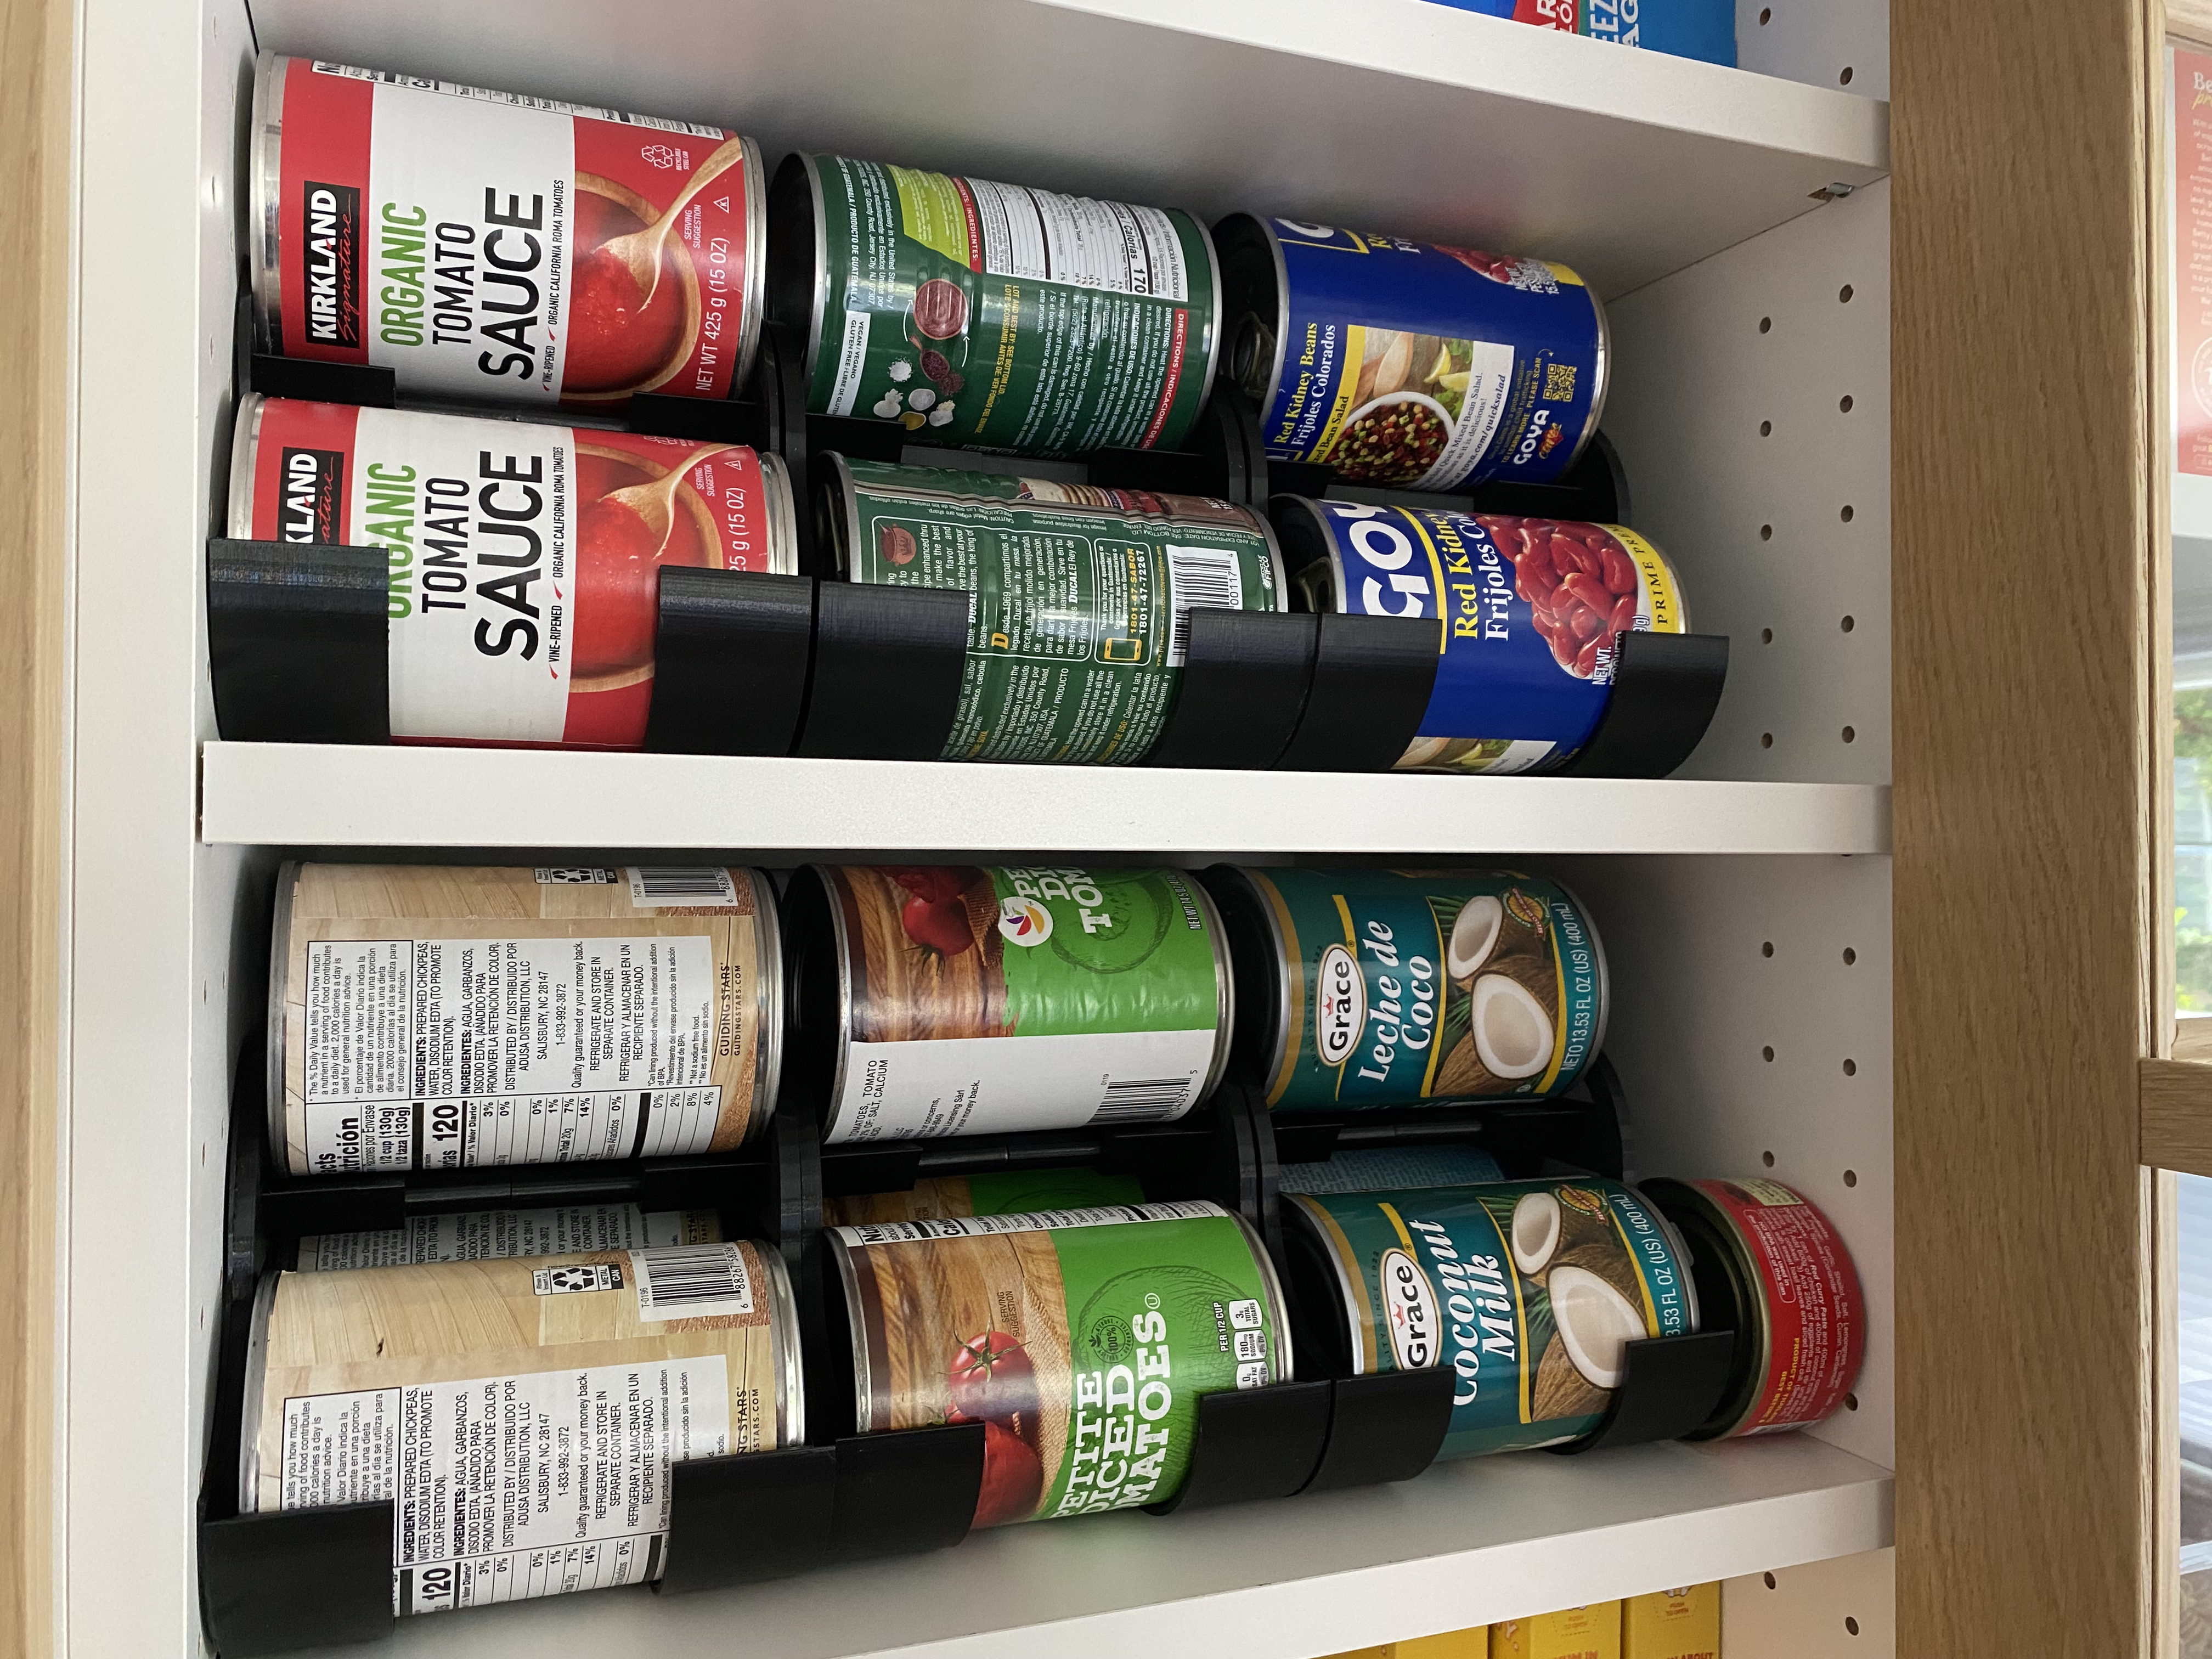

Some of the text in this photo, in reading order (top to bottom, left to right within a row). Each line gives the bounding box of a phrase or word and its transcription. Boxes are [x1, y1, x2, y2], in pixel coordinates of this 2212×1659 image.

[684, 210, 692, 240] SERVING
[693, 205, 702, 248] SUGGESTION
[311, 190, 336, 338] KIRKLAND
[338, 194, 359, 341] Signature
[381, 202, 426, 347] ORGANIC
[432, 222, 475, 345] TOMATO
[478, 187, 543, 380] SAUCE
[541, 180, 564, 382] VINE-RIPENED ORGANIC CALIFORNIA ROMA TOMATOES
[1132, 268, 1147, 294] 170
[695, 237, 729, 391] NET WT 425 g (15 OZ)
[848, 320, 857, 348] GLUTEN
[1009, 315, 1018, 333] BEST
[850, 321, 864, 379] VEGAN VEGANO
[1001, 358, 1014, 382] BOTTOM
[1007, 346, 1015, 357] SEE
[1153, 313, 1184, 430] DIRECTIONS INDICACIONES
[998, 384, 1006, 395] LID.
[1273, 323, 1317, 443] Red Kidney Beans
[1291, 325, 1335, 445] Frijoles Colorados
[1450, 373, 1482, 447] Mixed Bean Salad.
[1527, 358, 1542, 408] PLEASE SCAN
[1320, 397, 1348, 448] Bean Salad
[1514, 410, 1550, 464] GOYA
[286, 454, 317, 543] KLAND
[726, 487, 749, 535] (15 OZ)
[421, 478, 470, 613] TOMATO
[474, 451, 543, 661] SAUCE
[921, 524, 931, 573] enhanced thru
[1022, 536, 1032, 567] mejorada
[1262, 556, 1272, 580] FIFCO
[1319, 499, 1430, 618] GOY
[1001, 543, 1013, 610] 1969 compartimos
[1069, 571, 1078, 603] DUCAL
[1127, 548, 1138, 634] 1801-47-SABOR
[1136, 550, 1148, 634] 1801-47-72267
[1228, 571, 1239, 605] 00117
[1476, 544, 1513, 641] Frijoles
[1642, 561, 1667, 624] PRIME
[549, 606, 563, 662] VINE-RIPENED
[1453, 583, 1478, 639] Red
[1032, 667, 1051, 709] County Road,
[1054, 668, 1069, 703] PRODUCTO
[1592, 646, 1611, 685] NET WT.
[1184, 905, 1197, 915] WT
[1189, 917, 1201, 929] NET
[573, 941, 582, 960] back.
[574, 962, 585, 987] money
[575, 989, 585, 1006] your
[1329, 961, 1351, 1051] Grace
[1358, 921, 1402, 1082] Leche de
[1402, 956, 1434, 1049] Coco
[1551, 902, 1592, 1070] NETO 13.53 FL OZ (US) (400 mL)
[309, 955, 321, 1095] The Daily Value tells you how much
[415, 941, 429, 1096] INGREDIENTS: PREPARED CHICKPEAS,
[538, 972, 549, 1059] SALISBURY, NC 28147
[556, 984, 566, 1045] 1-833-992-3872
[574, 1018, 585, 1061] guaranteed
[720, 1005, 731, 1056] GUIDING
[572, 1064, 585, 1088] Quality
[703, 1092, 714, 1105] 4%
[850, 1060, 877, 1136] TOMATOES, TOMATO
[868, 1059, 888, 1117] SALT, CALCIUM
[961, 1080, 980, 1118] money back.
[432, 1105, 458, 1141] 120
[600, 1268, 610, 1285] METAL
[612, 1269, 620, 1281] CAN
[1609, 1194, 1680, 1335] 3.53 FL OZ (US) (400 mL)
[640, 1288, 650, 1307] T-0196
[997, 1291, 1009, 1322] SERVING
[1006, 1290, 1020, 1338] SUGGESTION
[1250, 1302, 1259, 1324] SUGARS
[1396, 1266, 1427, 1367] Grace
[1409, 1220, 1479, 1406] Coconut
[1463, 1255, 1516, 1361] Milk
[1810, 1265, 1828, 1328] Red Curry Paste
[1107, 1327, 1119, 1352] 100%
[1214, 1302, 1229, 1351] PER 1/2 CUP
[1790, 1338, 1799, 1378] PRODUCT
[1120, 1311, 1171, 1508] MATOES
[558, 1426, 569, 1496] 1-833-992-3872
[643, 1396, 653, 1504] RECIPIENTE SEPARADO.
[1052, 1372, 1102, 1518] PETITE
[1080, 1364, 1135, 1513] DICED
[404, 1388, 420, 1562] INGREDIENTS: PREPARED CHICKPEAS,
[421, 1568, 451, 1600] 120
